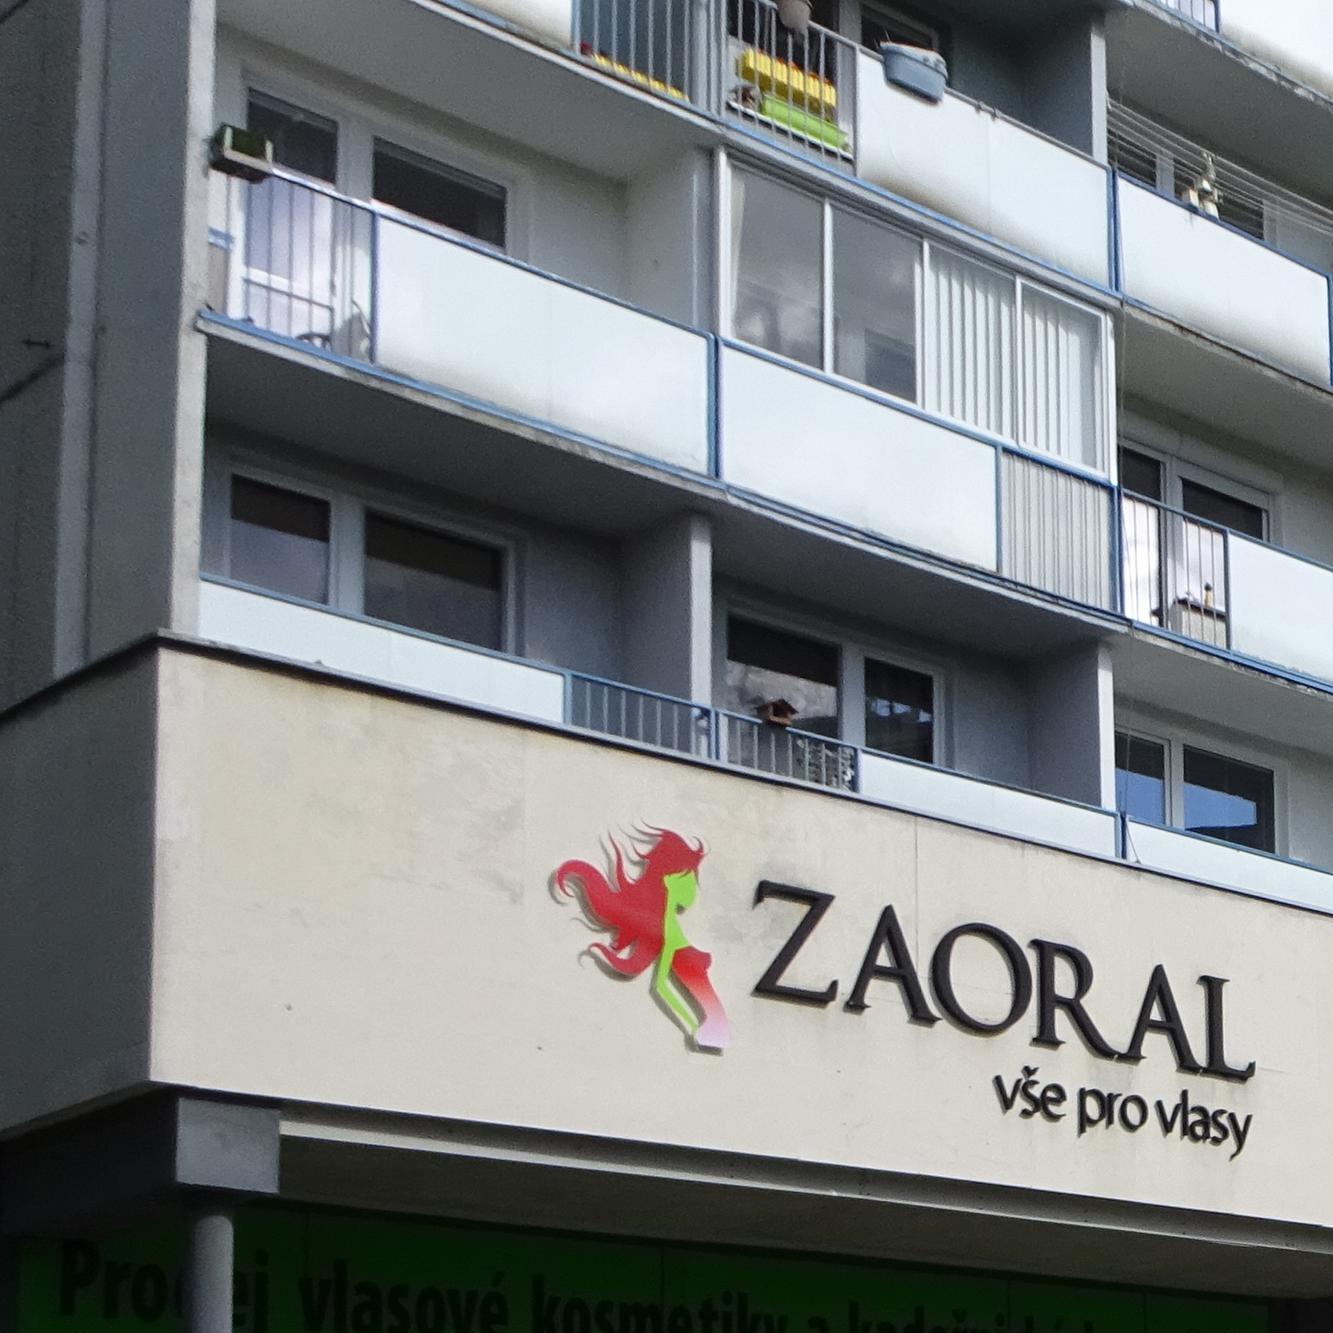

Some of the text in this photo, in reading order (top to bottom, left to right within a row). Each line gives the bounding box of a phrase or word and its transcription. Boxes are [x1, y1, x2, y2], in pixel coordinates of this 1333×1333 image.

[752, 879, 1256, 1082] ZAORAL
[993, 1066, 1254, 1161] vše pro vlasy
